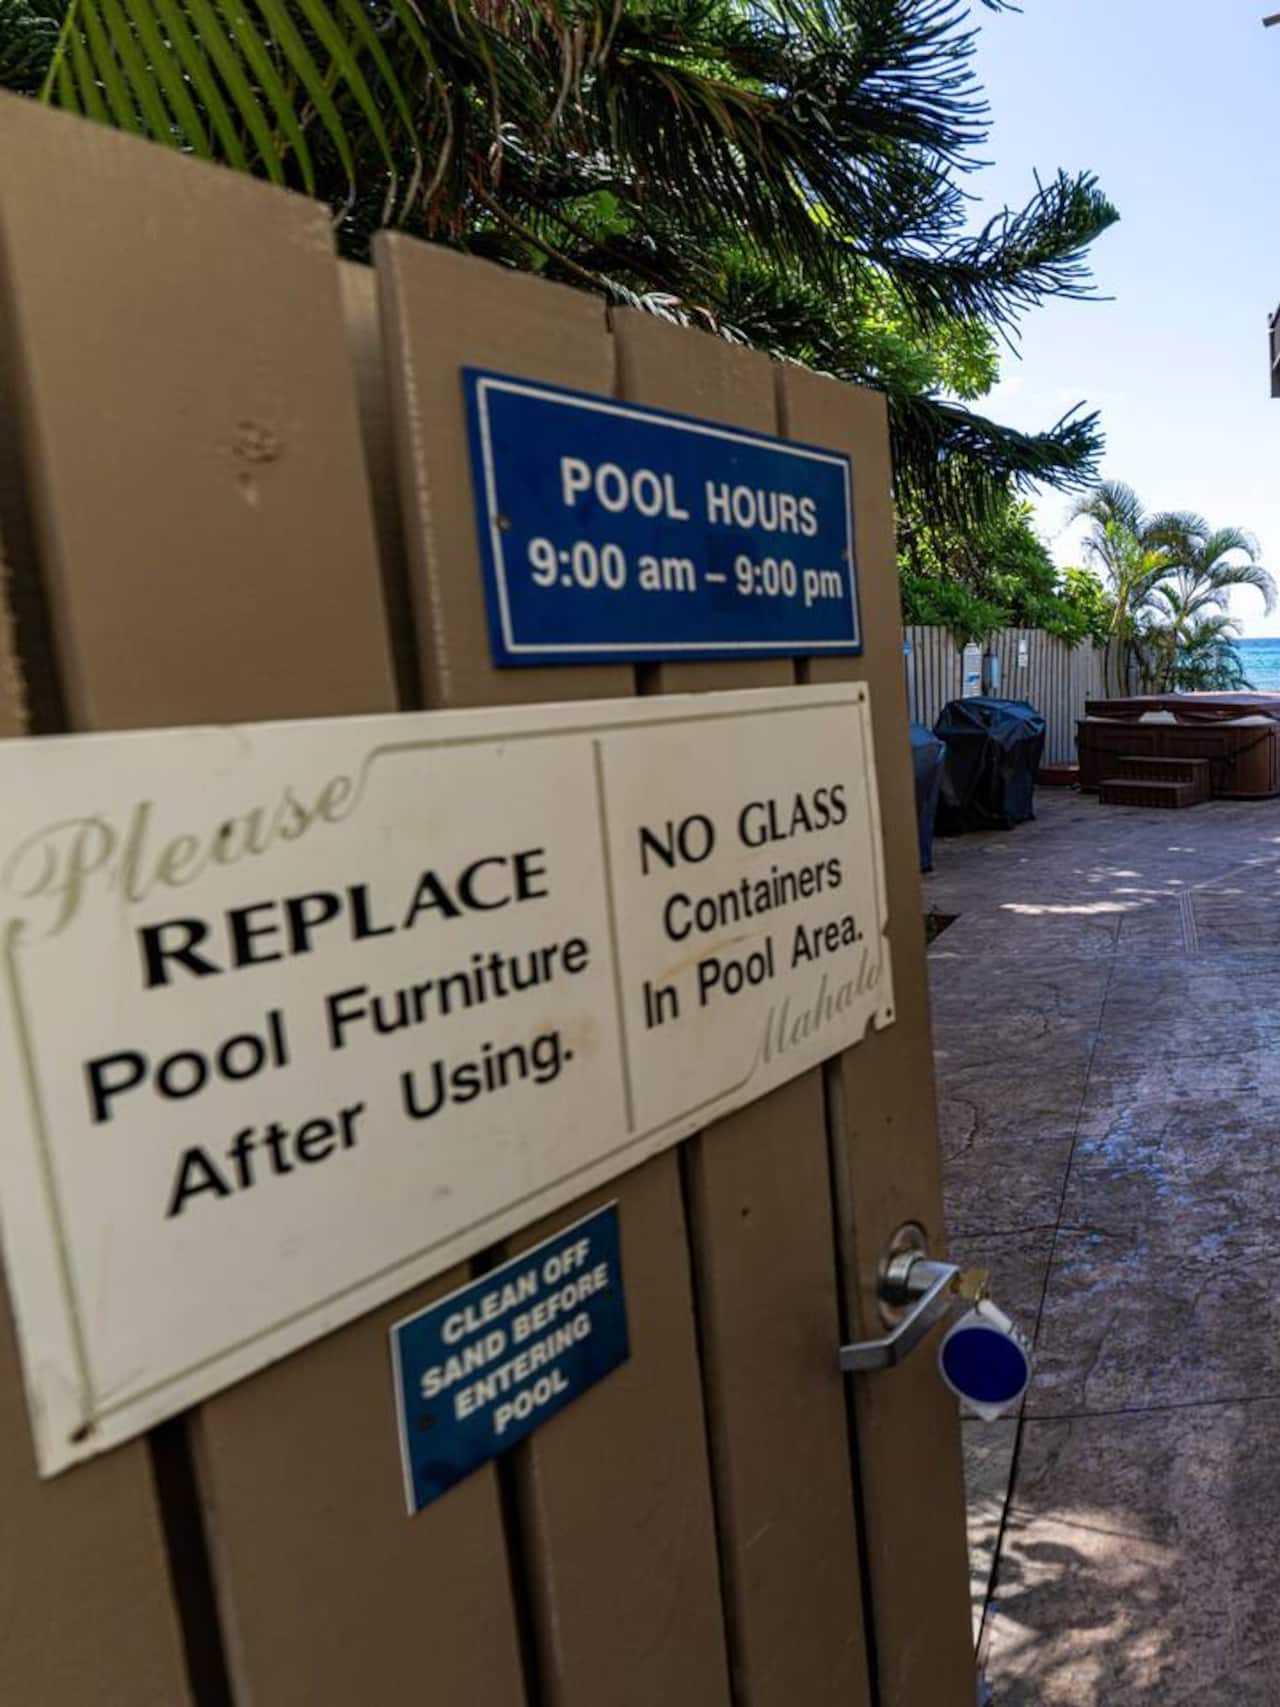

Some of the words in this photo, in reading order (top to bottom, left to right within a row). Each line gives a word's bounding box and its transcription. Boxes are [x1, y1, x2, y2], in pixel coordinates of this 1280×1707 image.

[560, 456, 690, 521] POOL
[704, 480, 818, 537] HOURS
[528, 537, 627, 589] 9:00
[638, 555, 696, 592] am
[734, 555, 798, 596] 9:00
[803, 571, 843, 607] pm
[4, 774, 354, 944] Please
[638, 813, 715, 876] NO
[738, 783, 848, 848] GLASS
[137, 847, 549, 990] REPLACE
[663, 857, 842, 942] Containers
[642, 979, 680, 1029] In
[697, 936, 774, 1007] Pool
[790, 914, 864, 968] Area.
[83, 1009, 289, 1124] Pool
[323, 936, 590, 1051] Furniture
[164, 1102, 365, 1219] After
[400, 1029, 575, 1121] Using.
[420, 1328, 506, 1400] SAND
[511, 1263, 608, 1344] BEFORE
[442, 1271, 539, 1345] CLEAN
[542, 1237, 590, 1285] OFF
[453, 1312, 592, 1421] ENTERING
[493, 1367, 568, 1435] POOL
